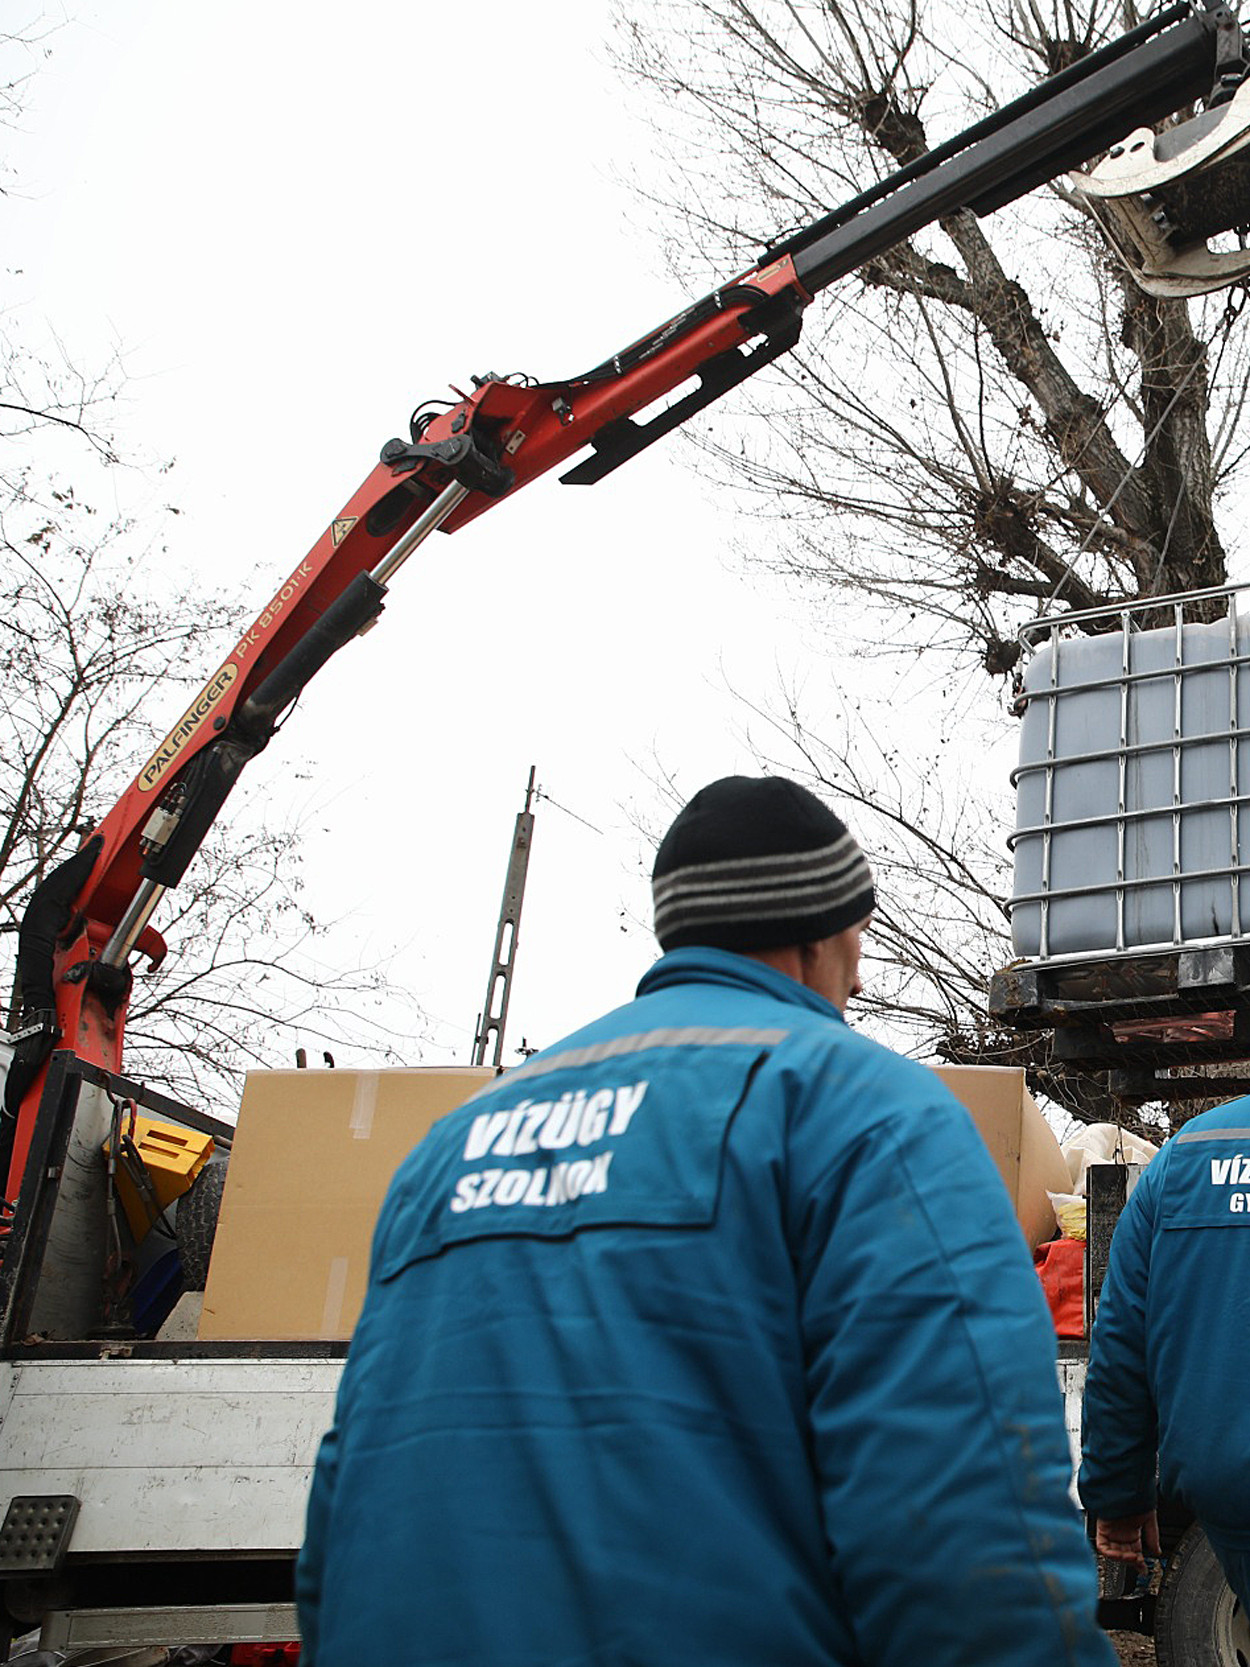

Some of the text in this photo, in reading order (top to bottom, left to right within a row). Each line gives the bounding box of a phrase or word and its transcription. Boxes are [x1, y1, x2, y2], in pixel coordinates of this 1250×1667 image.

[236, 632, 260, 658] PK
[143, 671, 233, 784] PALFINGER
[463, 1080, 649, 1161] VÍZÜGY
